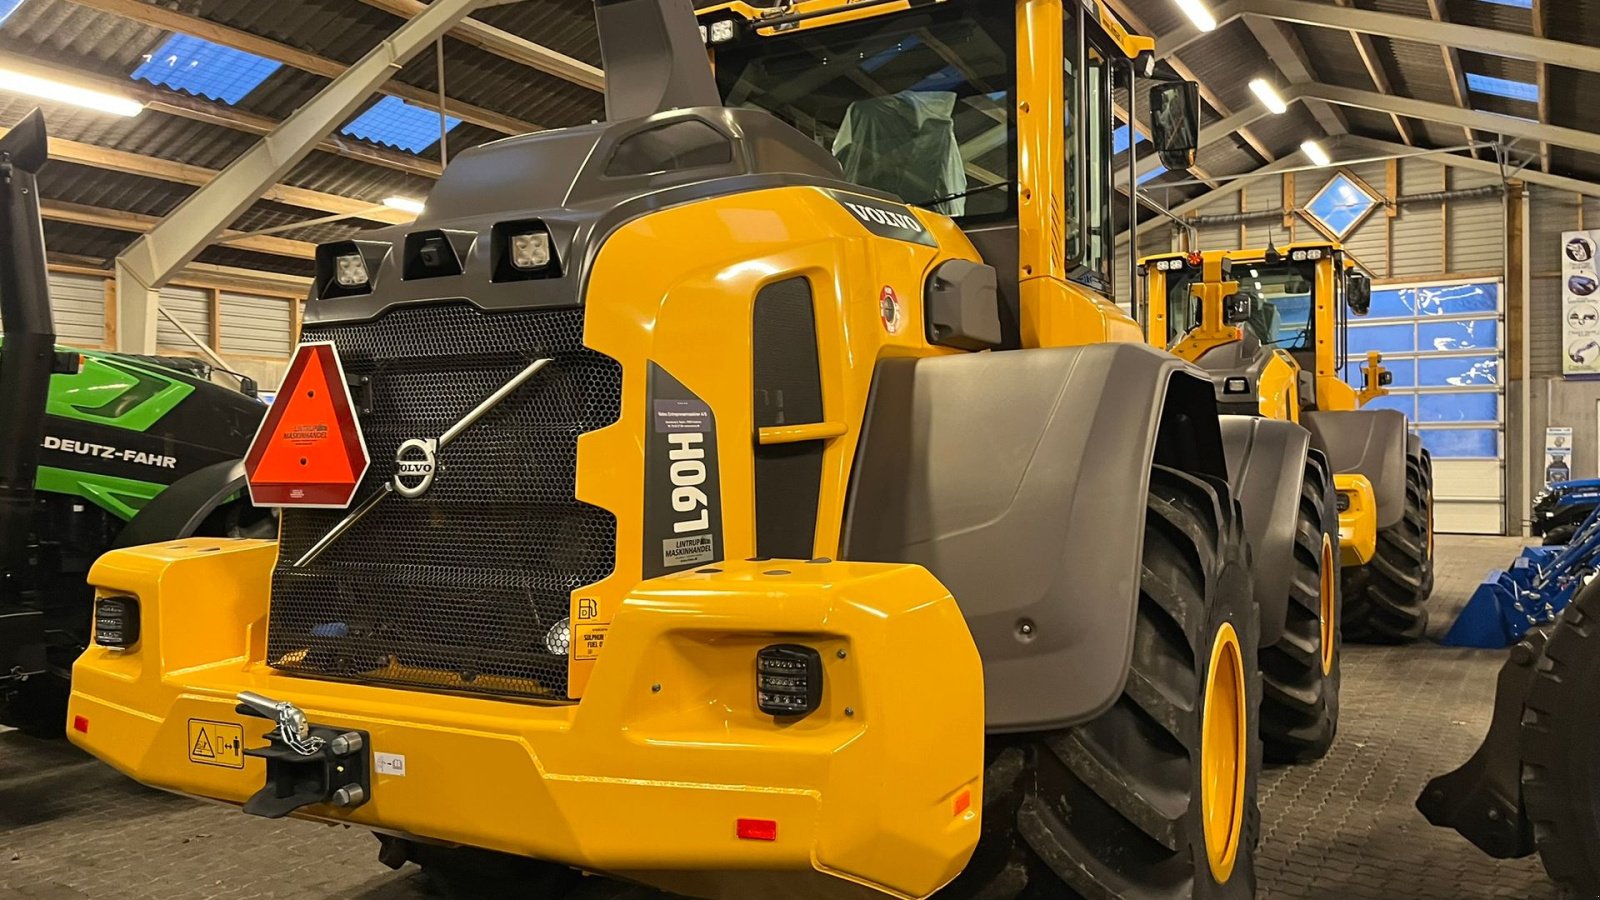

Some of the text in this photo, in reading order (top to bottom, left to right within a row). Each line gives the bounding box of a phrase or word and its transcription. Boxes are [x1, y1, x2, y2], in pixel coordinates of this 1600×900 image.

[844, 201, 921, 232] VOLVO
[43, 436, 177, 469] DEUTZ-FAHR
[668, 432, 709, 534] L90H
[665, 545, 712, 557] MASKINHANDEL
[676, 538, 700, 548] LINTRUP
